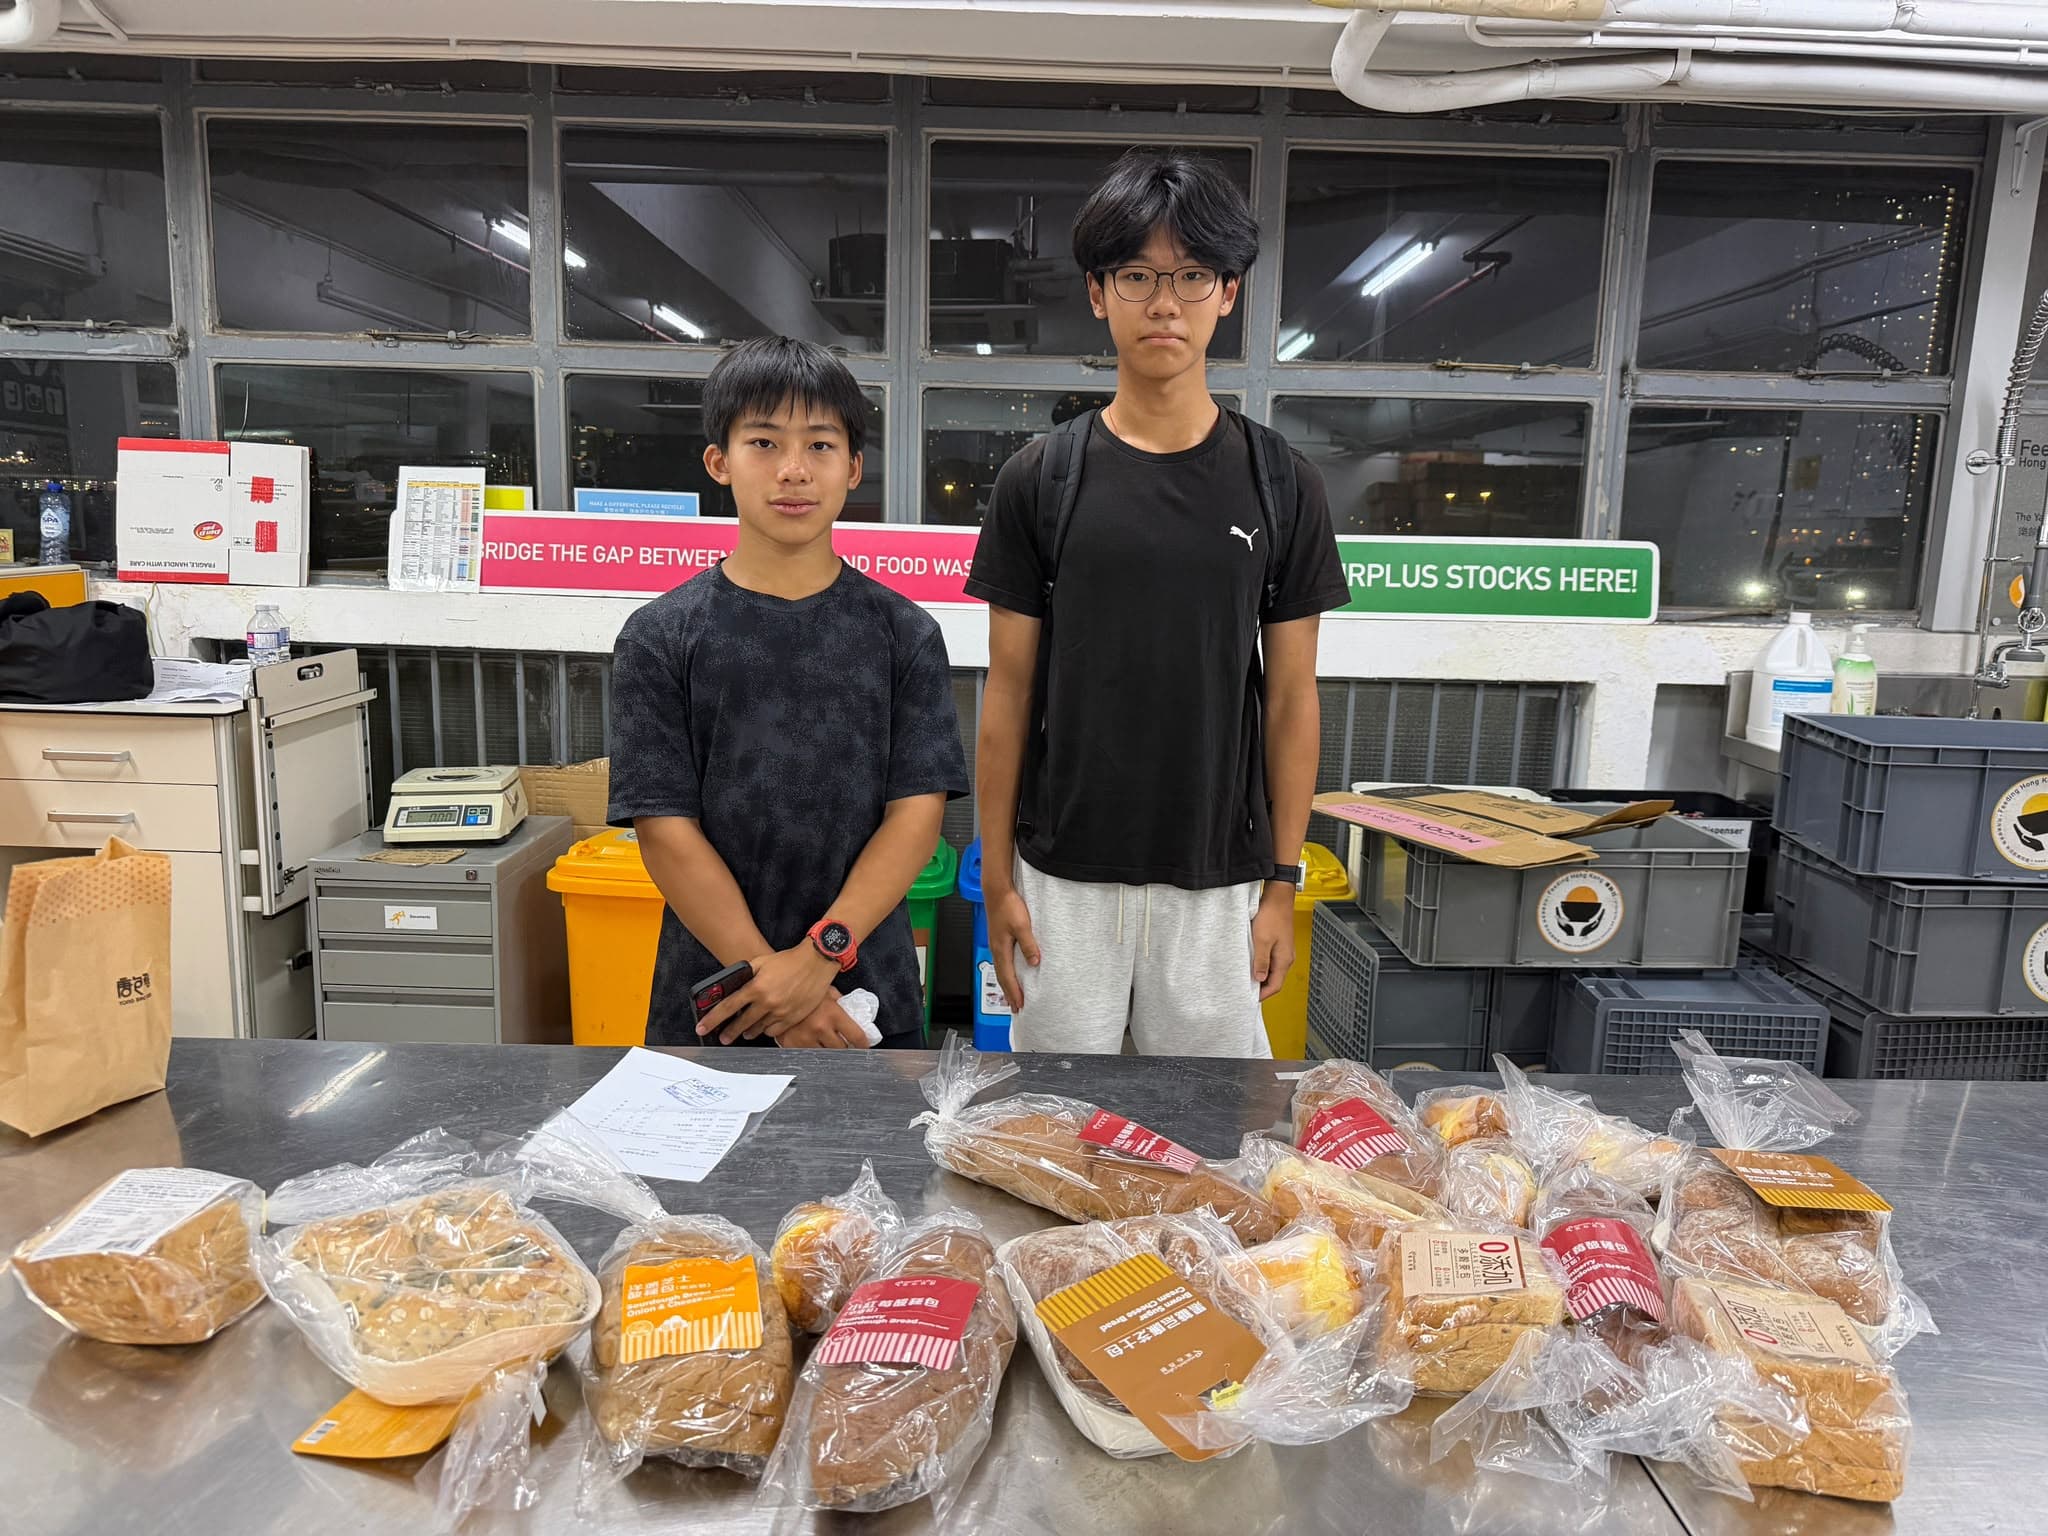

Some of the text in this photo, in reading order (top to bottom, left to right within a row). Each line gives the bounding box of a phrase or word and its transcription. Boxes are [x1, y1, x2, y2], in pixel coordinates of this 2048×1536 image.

[2019, 456, 2046, 470] Hong
[2016, 511, 2032, 522] The
[482, 541, 544, 561] RIDGE
[549, 543, 588, 562] THE
[593, 545, 634, 564] GAP
[842, 555, 870, 573] ND
[876, 556, 928, 575] FOOD
[1445, 565, 1552, 590] STOCKS
[1559, 567, 1638, 593] HERE!
[626, 1294, 681, 1310] Sourdough
[626, 1306, 657, 1318] Onion
[667, 1297, 703, 1308] Cheese
[1099, 1286, 1186, 1333] Cream Cheese Bread
[1139, 1291, 1193, 1322] Brown Sugar
[1104, 1300, 1207, 1358] 黑糖忌廉芝士包
